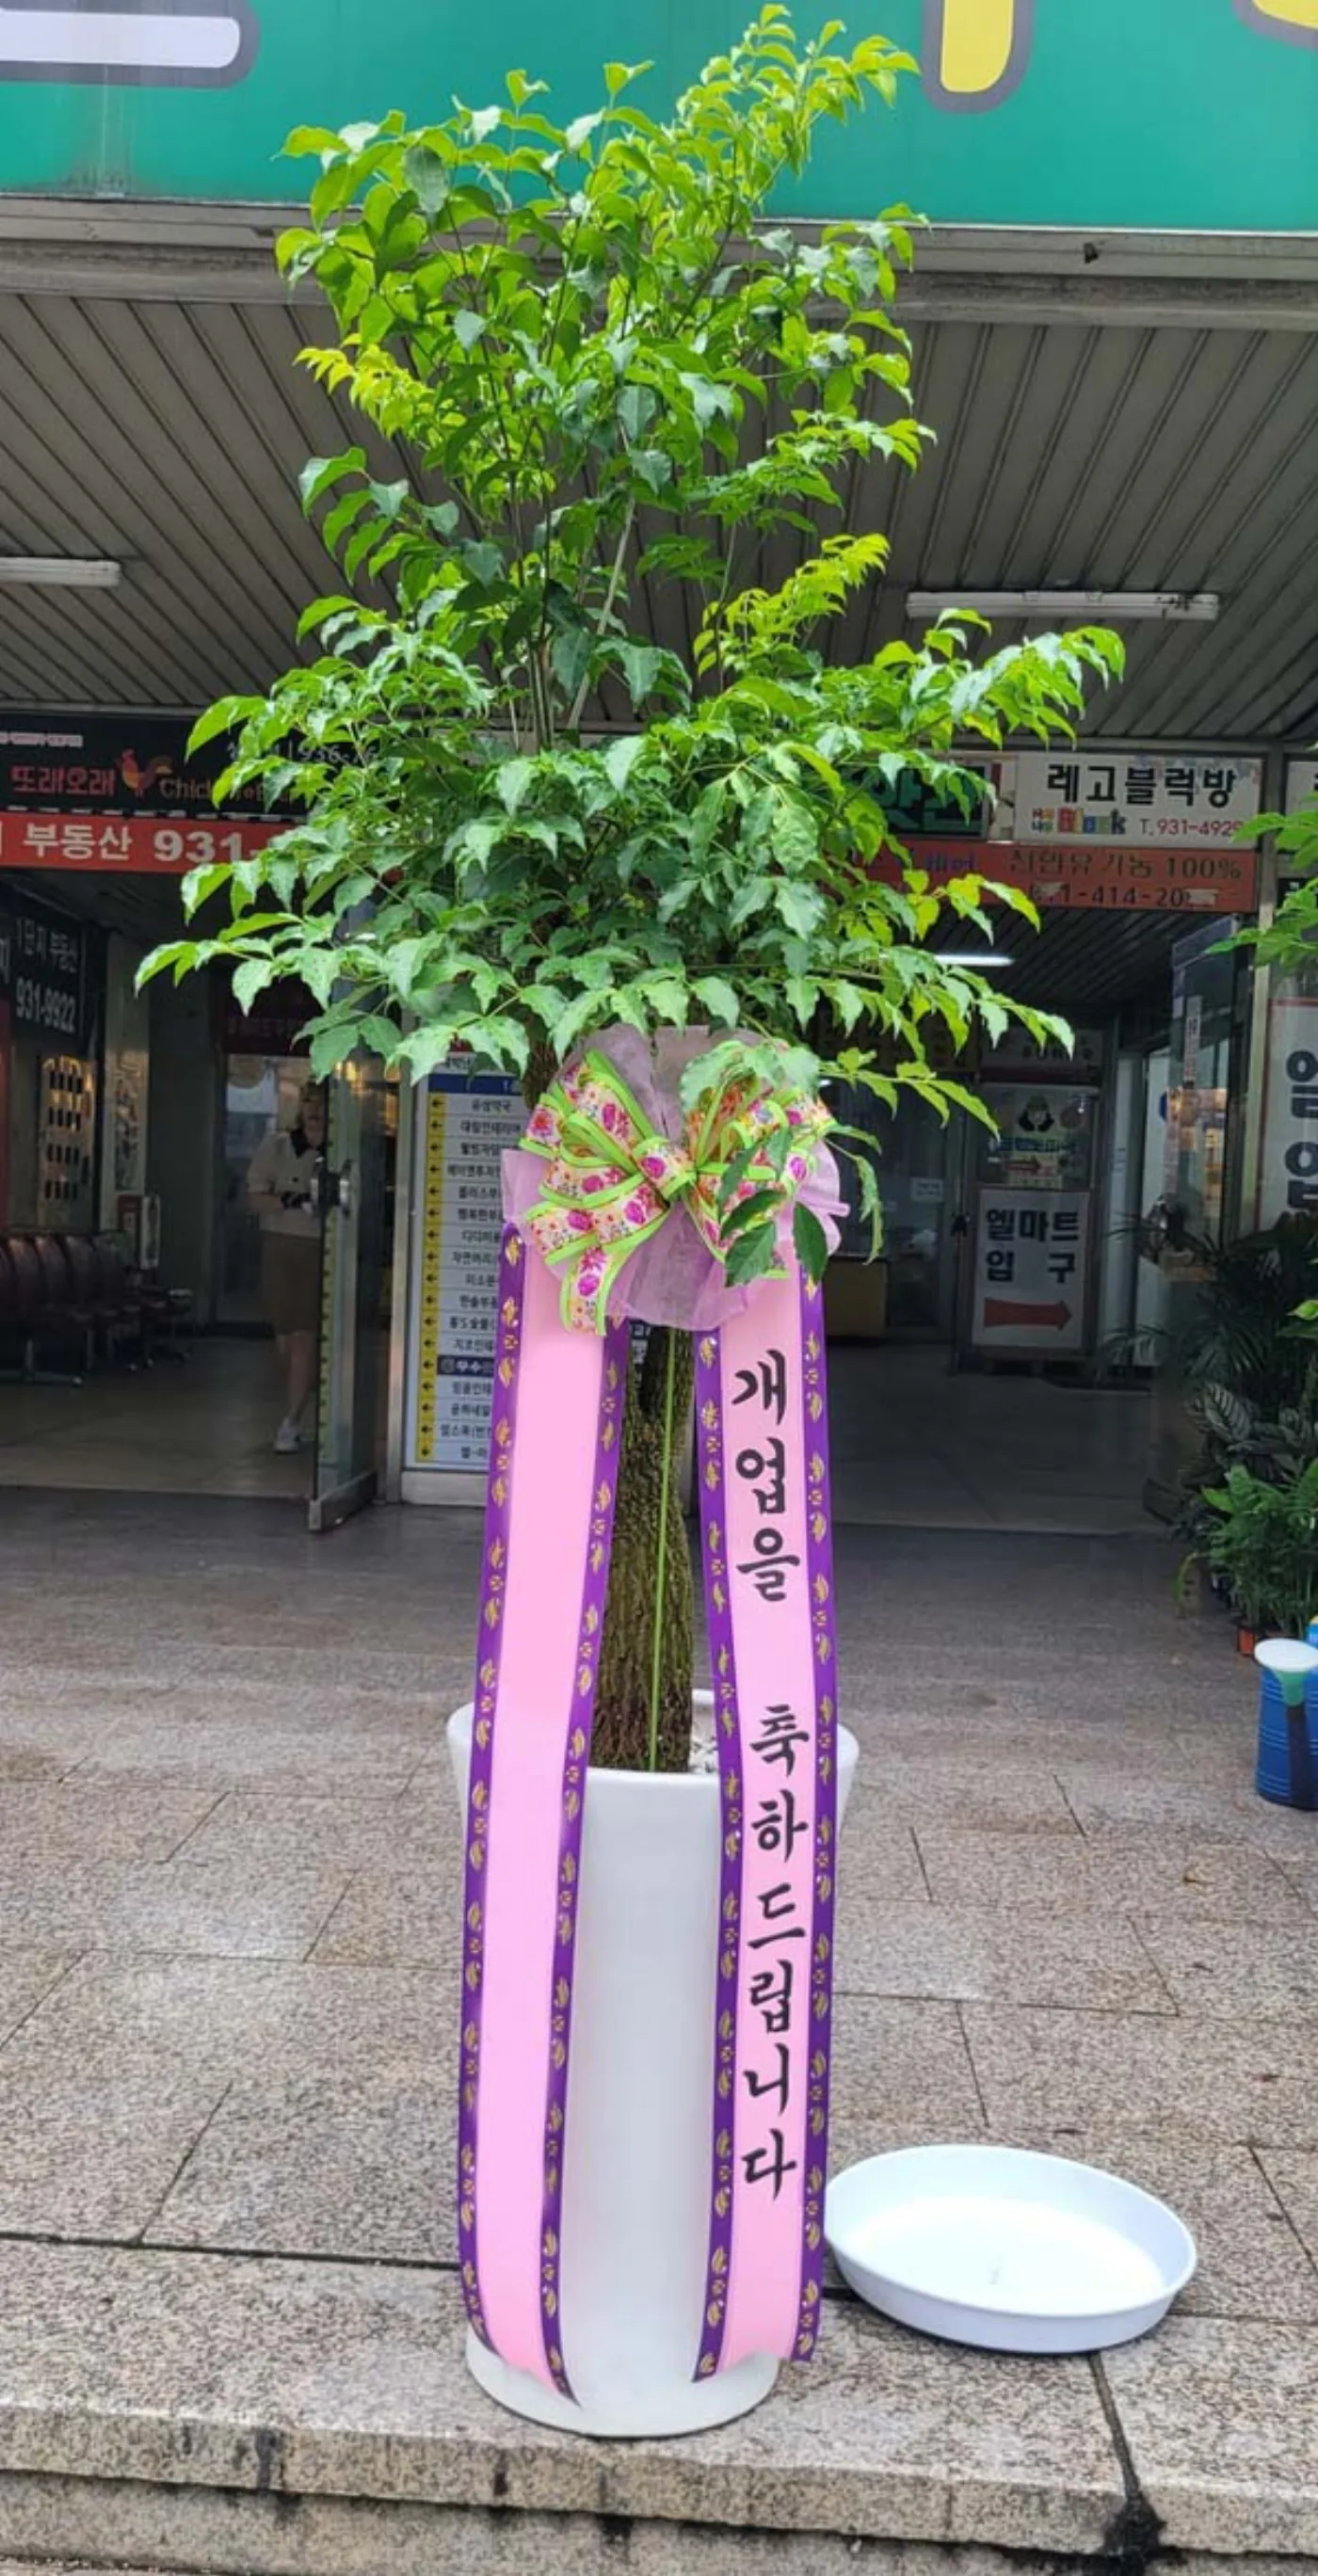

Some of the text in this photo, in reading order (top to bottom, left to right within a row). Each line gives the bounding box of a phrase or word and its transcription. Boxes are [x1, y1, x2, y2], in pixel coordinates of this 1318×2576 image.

[11, 766, 115, 796] 또래오래
[1047, 764, 1237, 808] 레고블럭방
[24, 822, 133, 861] 부동산
[986, 1208, 1079, 1242] 엘마트
[731, 1349, 810, 2200] 개업을 축하드립니다
